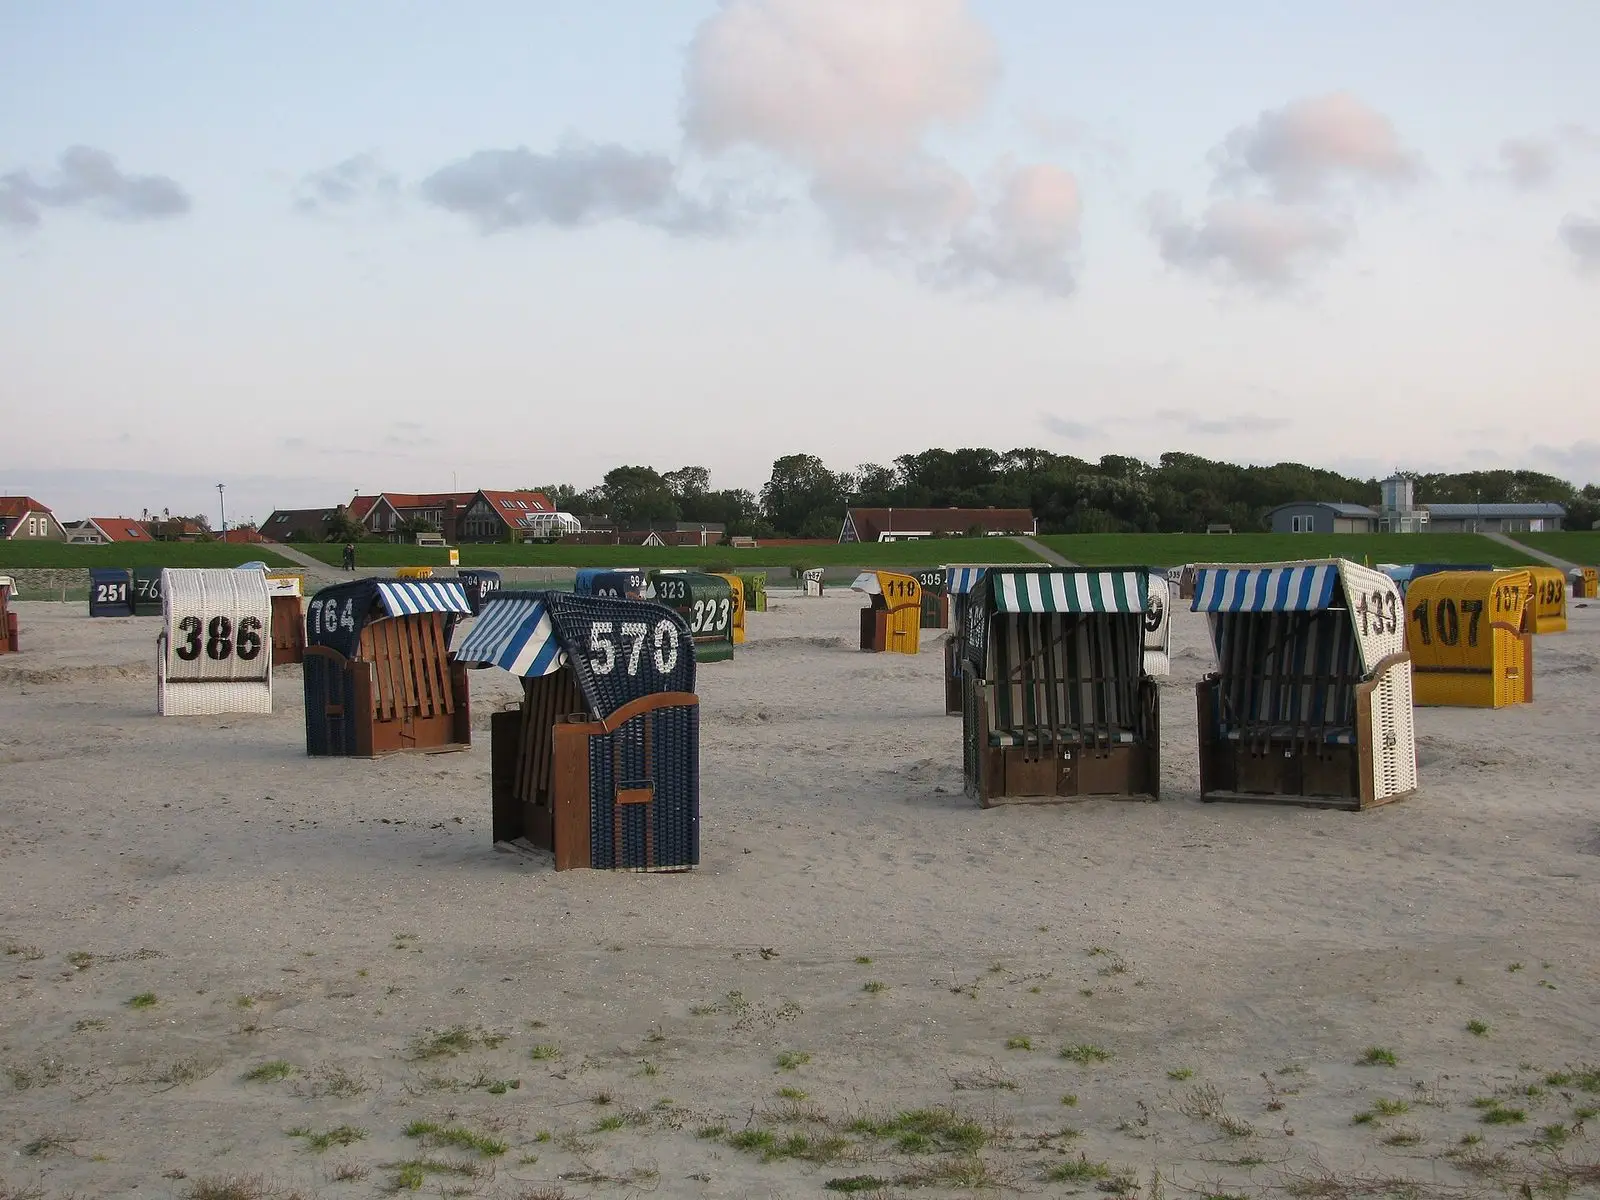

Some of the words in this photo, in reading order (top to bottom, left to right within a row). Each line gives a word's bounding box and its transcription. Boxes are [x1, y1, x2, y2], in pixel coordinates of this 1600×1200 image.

[630, 575, 640, 587] 99
[660, 580, 685, 599] 323
[920, 573, 941, 586] 305
[1169, 570, 1180, 579] 335
[97, 584, 126, 602] 251
[1538, 579, 1563, 606] 193
[312, 598, 355, 634] 764
[691, 598, 730, 633] 323
[1357, 590, 1397, 637] 133
[1412, 597, 1484, 648] 107
[176, 615, 263, 661] 386
[590, 618, 679, 676] 570
